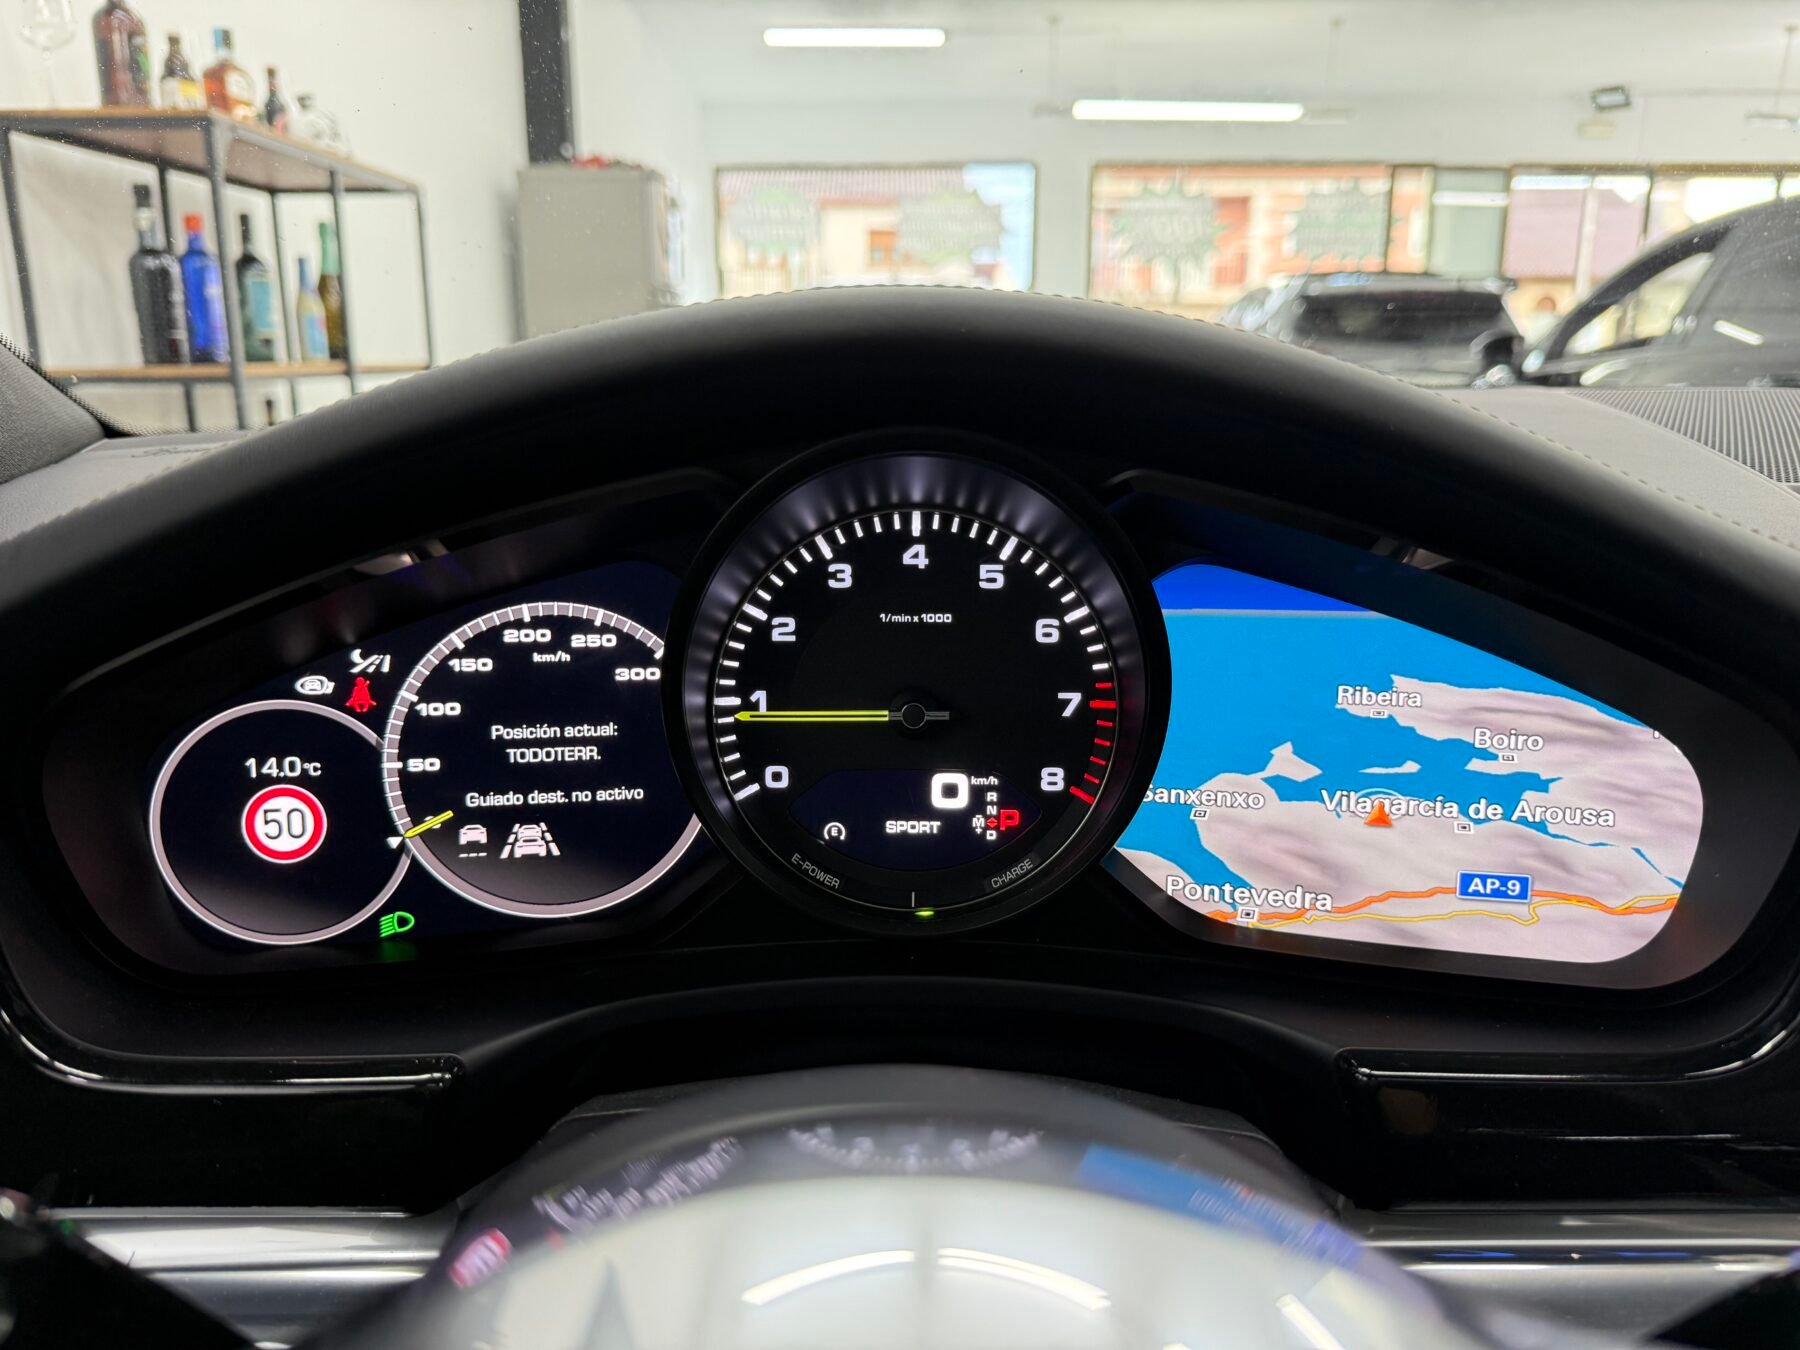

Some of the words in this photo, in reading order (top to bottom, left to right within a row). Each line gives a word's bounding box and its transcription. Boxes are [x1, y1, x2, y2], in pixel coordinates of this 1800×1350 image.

[902, 544, 929, 569] 4
[828, 563, 852, 589] 3
[979, 564, 1005, 589] 5
[879, 613, 911, 623] 1/min
[912, 615, 919, 623] x
[921, 613, 952, 623] 1000
[503, 629, 552, 643] 200
[771, 617, 796, 642] 2
[1035, 618, 1060, 643] 6
[570, 634, 617, 648] 250
[448, 657, 494, 672] 150
[532, 651, 571, 662] km/h
[614, 667, 661, 681] 300
[749, 690, 767, 713] 1
[1057, 692, 1082, 717] 7
[1336, 685, 1423, 708] Ribeira
[414, 701, 462, 717] 100
[490, 723, 561, 740] Posición
[564, 722, 618, 738] actual:
[1472, 727, 1545, 751] Boiro
[406, 757, 441, 772] 50
[505, 746, 602, 764] TODOTERR.
[765, 765, 789, 789] 0
[970, 775, 999, 785] km/h
[1041, 767, 1065, 791] 8
[465, 791, 524, 807] Guiado
[527, 789, 569, 804] dest.
[571, 791, 592, 802] no
[596, 786, 644, 801] activo
[931, 772, 970, 809] 0
[986, 791, 998, 802] R
[986, 805, 998, 815] N
[1000, 809, 1020, 831] P
[1468, 797, 1504, 821] de
[1510, 799, 1616, 827] Arousa
[263, 807, 306, 840] 50
[885, 821, 941, 834] SPORT
[986, 830, 997, 840] D
[791, 852, 841, 889] E-POWER
[990, 857, 1034, 889] CHARGE
[1166, 874, 1333, 911] Pontevedra
[1467, 877, 1522, 896] AP-9
